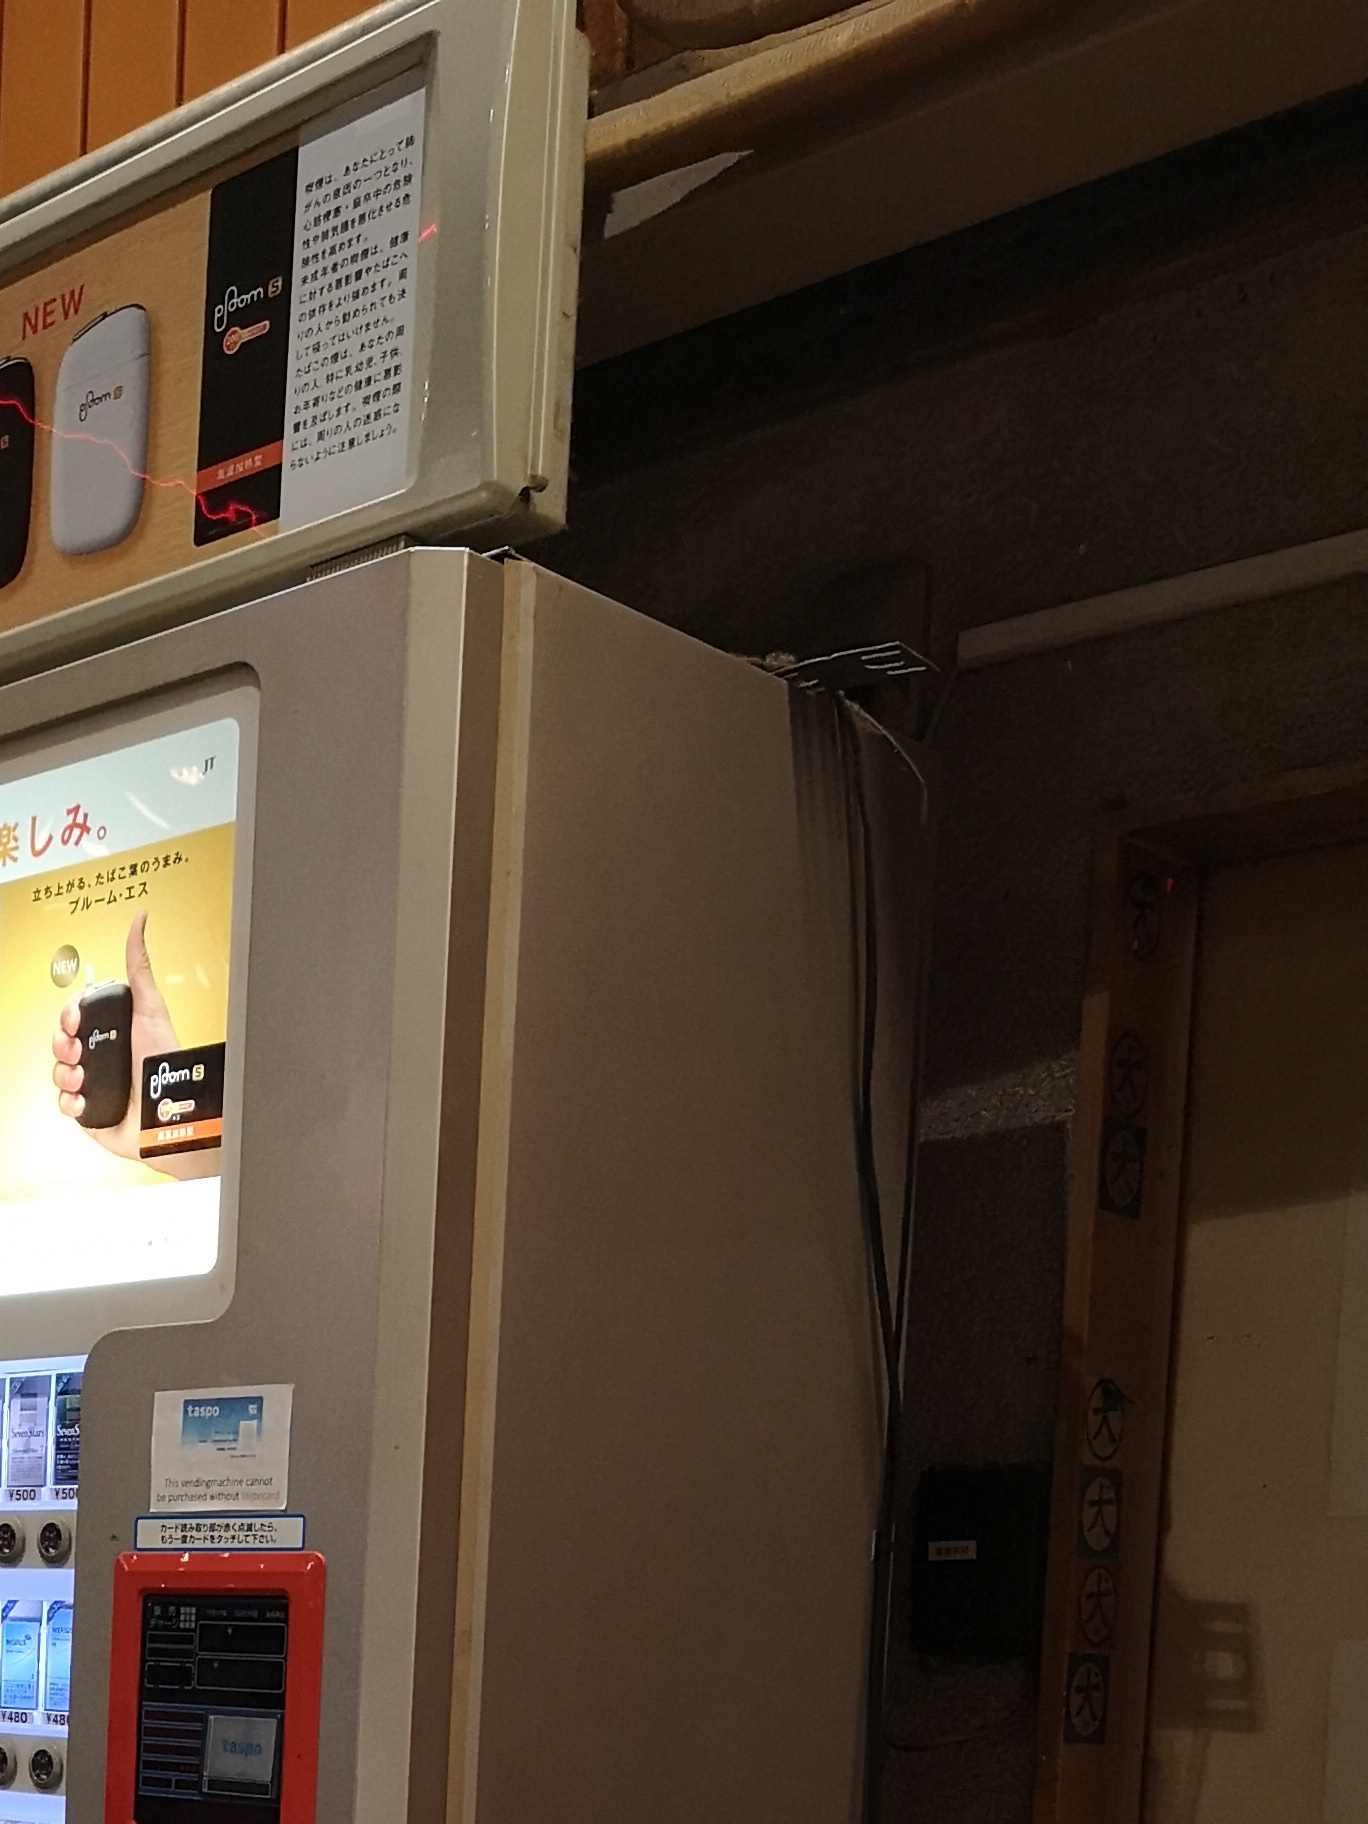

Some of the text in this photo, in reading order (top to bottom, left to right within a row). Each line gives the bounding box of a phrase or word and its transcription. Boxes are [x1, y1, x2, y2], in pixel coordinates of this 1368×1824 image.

[21, 284, 85, 340] NEW
[202, 755, 217, 775] JT
[52, 957, 78, 976] NEW
[186, 1404, 220, 1419] taspo
